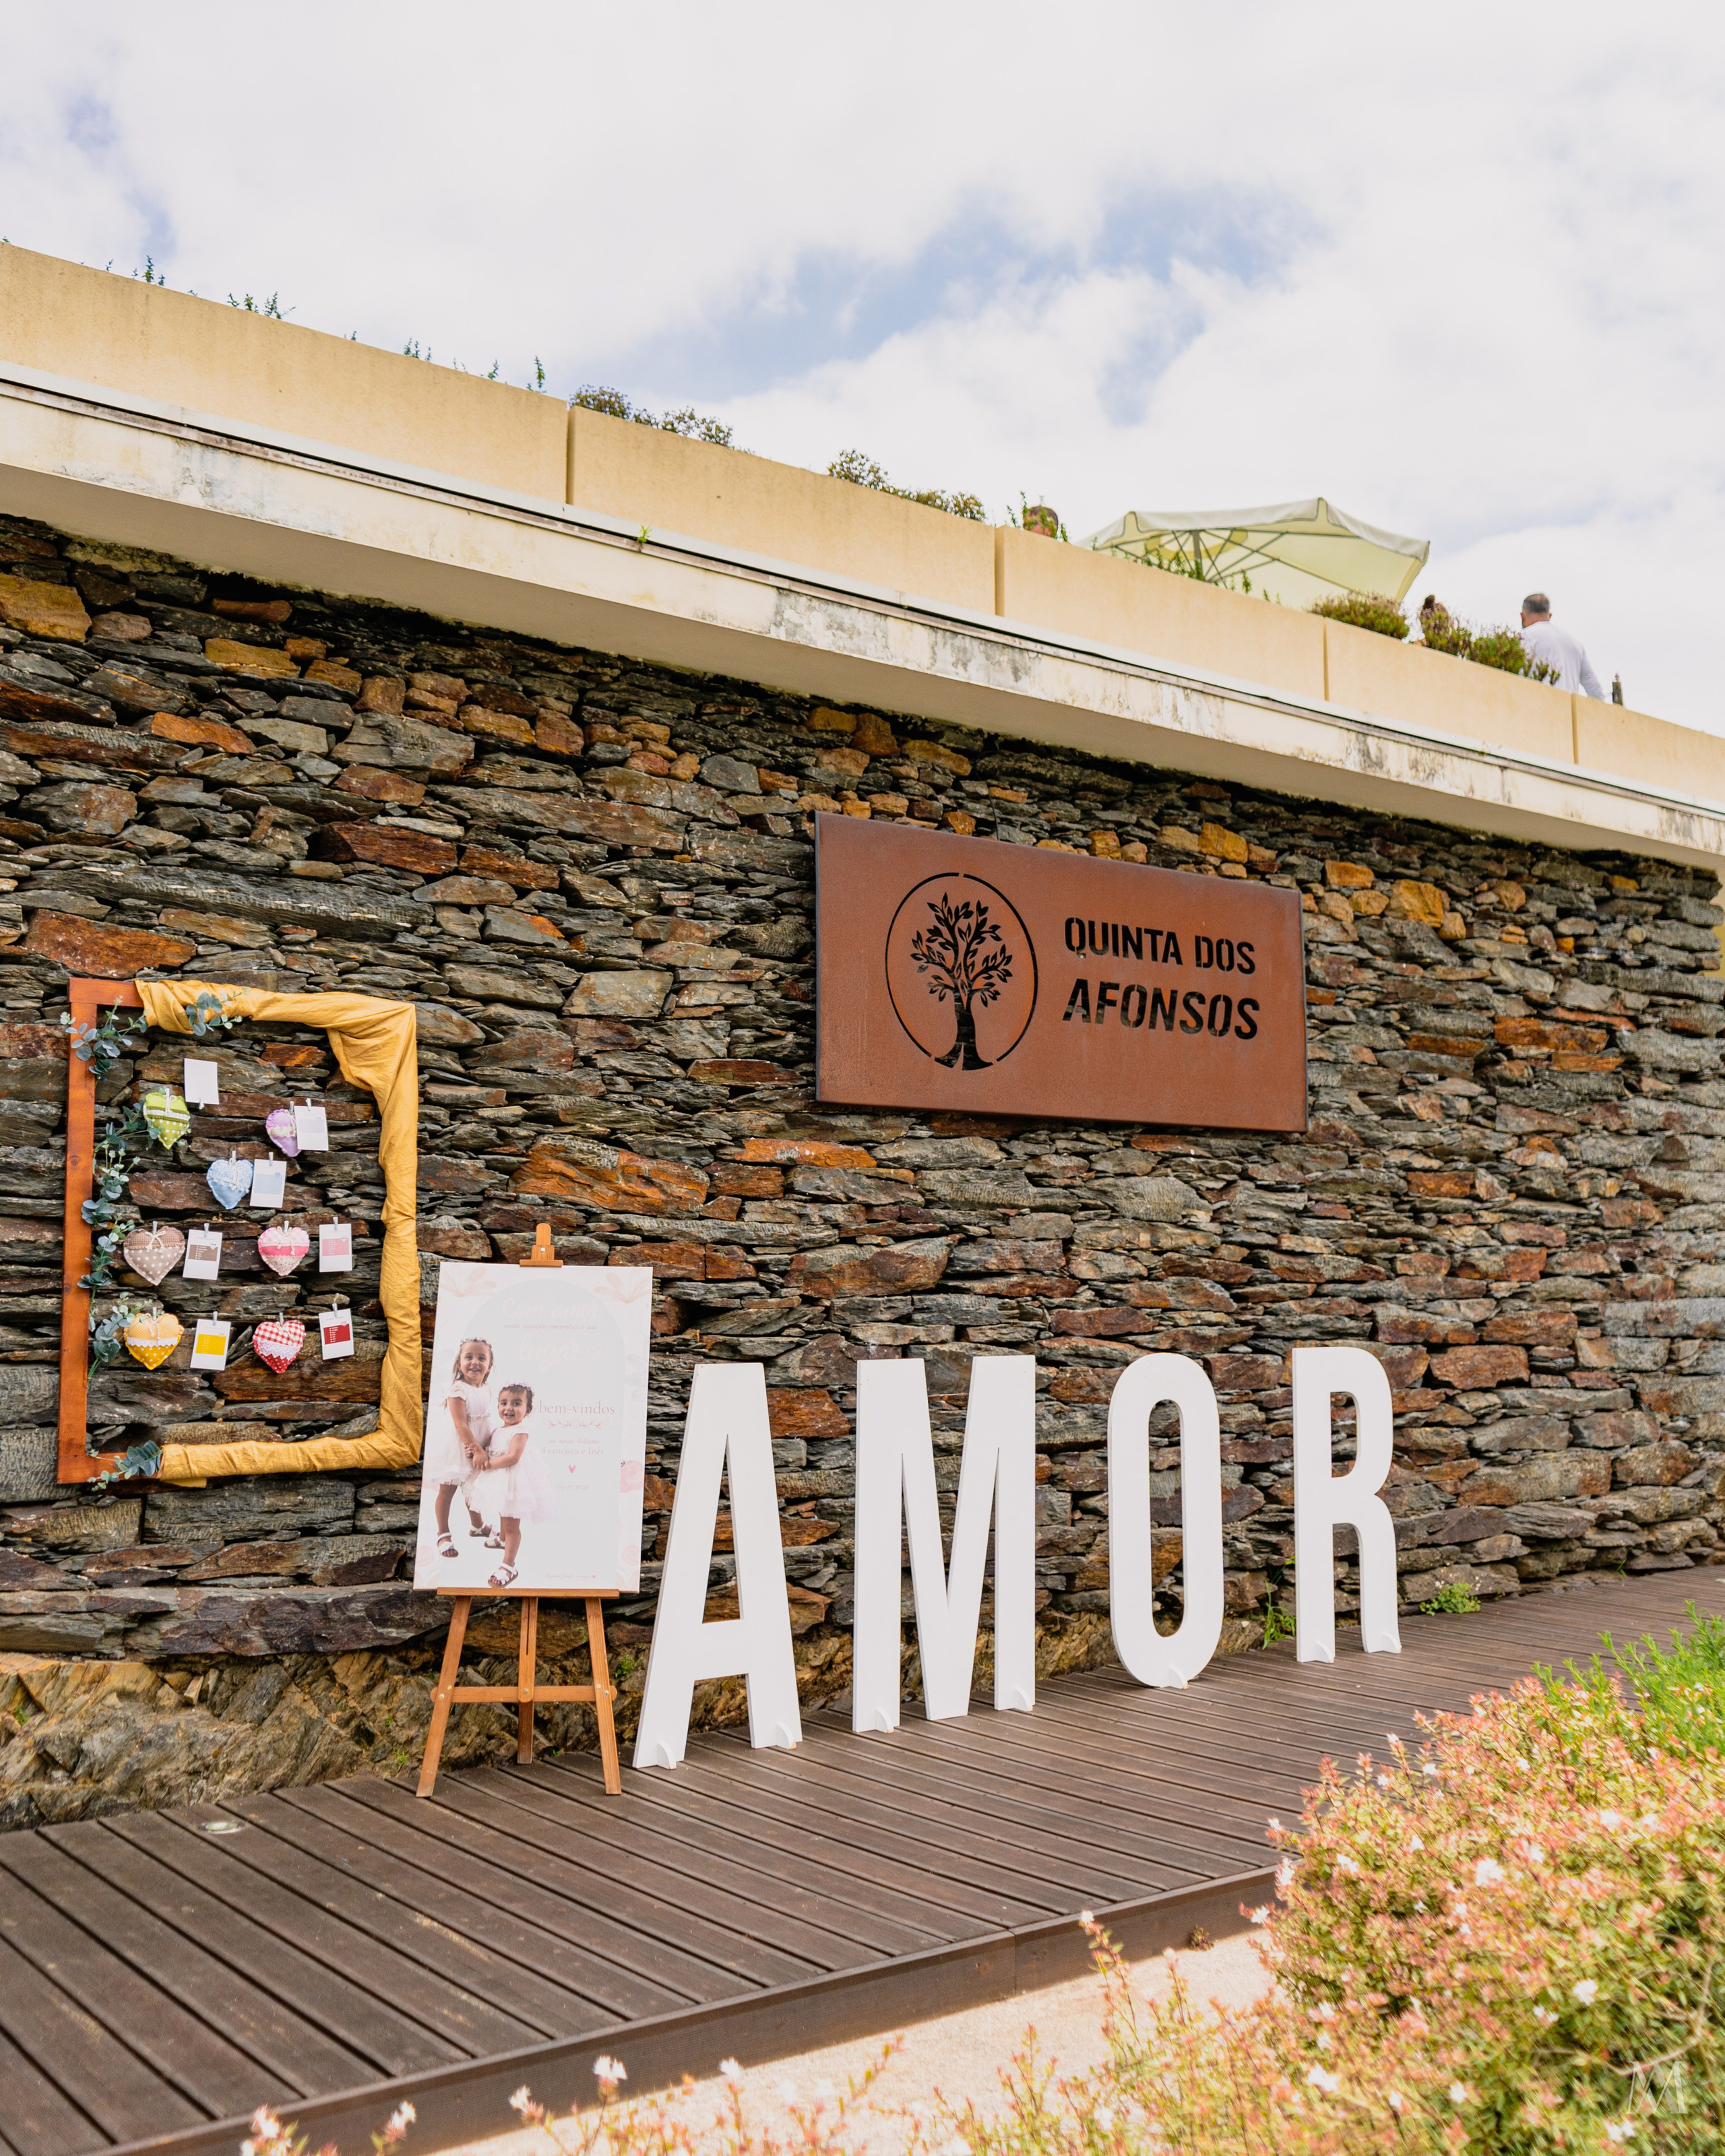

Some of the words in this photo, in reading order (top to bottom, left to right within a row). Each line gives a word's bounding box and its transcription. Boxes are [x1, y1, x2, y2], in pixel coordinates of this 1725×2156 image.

[1065, 917, 1183, 965] QUINTA
[1195, 935, 1256, 975] DOS
[1062, 978, 1260, 1040] AFONSOS
[519, 1333, 582, 1371] lugar
[539, 1400, 615, 1414] bem-vindos
[543, 1447, 579, 1455] Francisca
[588, 1447, 604, 1455] Inês
[632, 1346, 1402, 1769] AMOR
